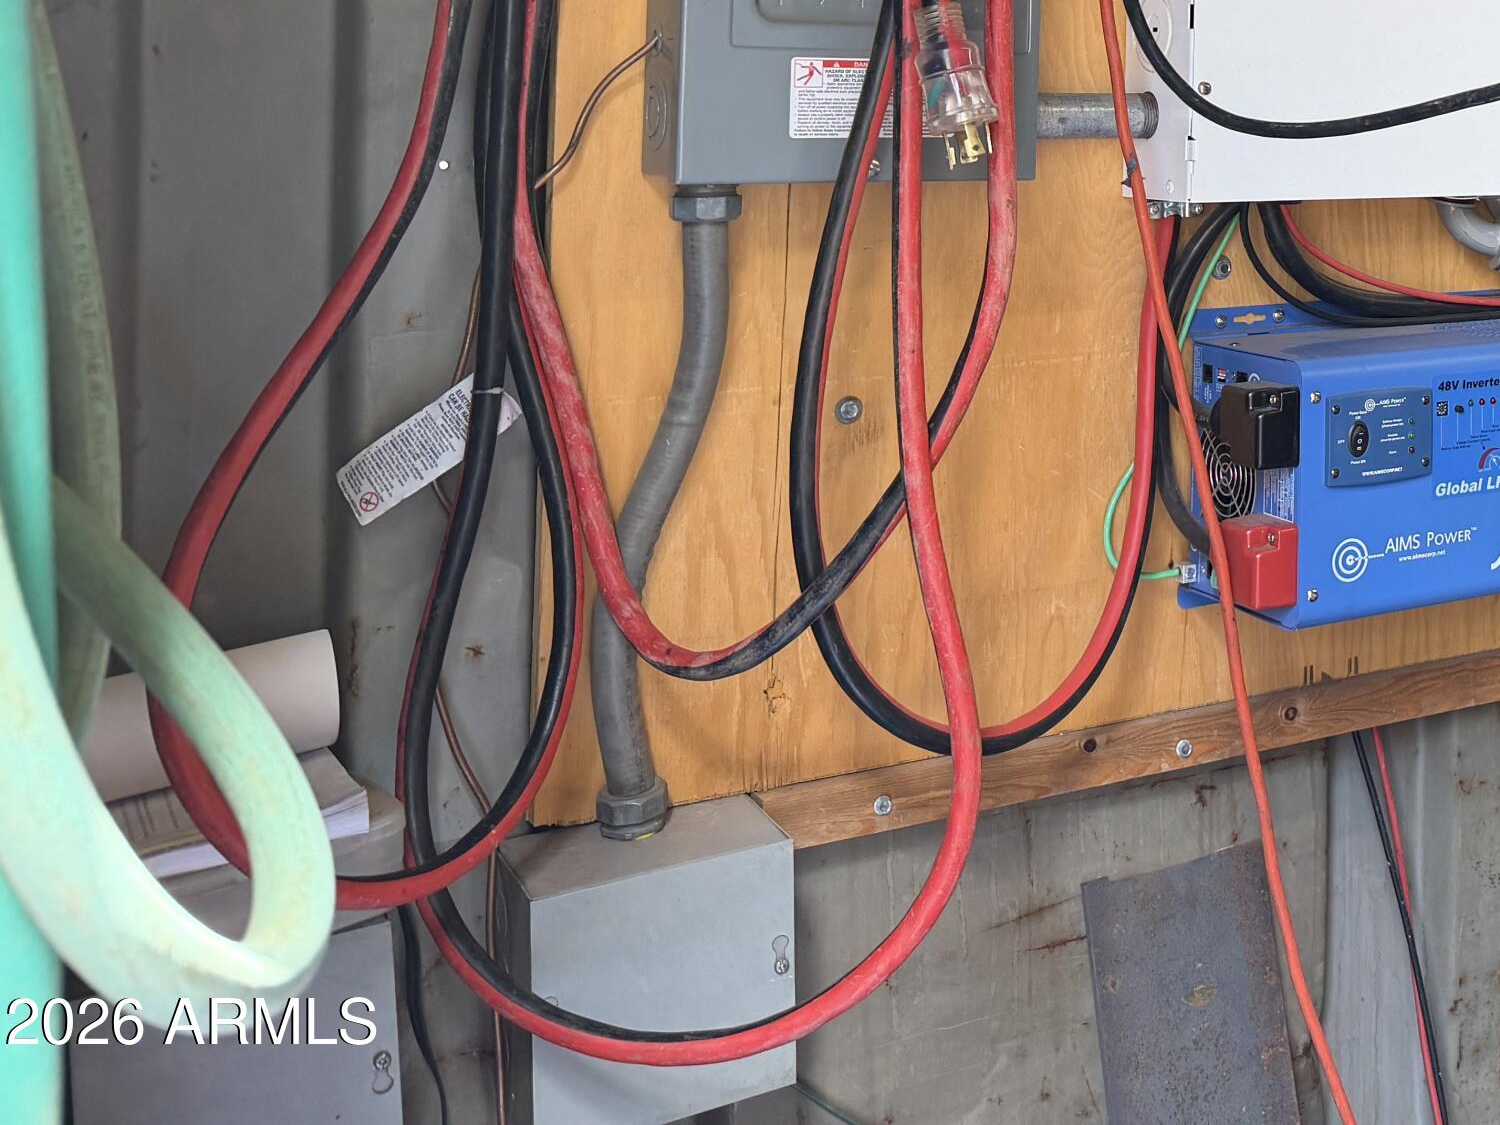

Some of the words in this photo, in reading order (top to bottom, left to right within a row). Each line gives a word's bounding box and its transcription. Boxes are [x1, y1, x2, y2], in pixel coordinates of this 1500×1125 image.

[1438, 379, 1460, 392] 48V
[1435, 478, 1483, 497] Global
[1385, 533, 1421, 554] AIMS
